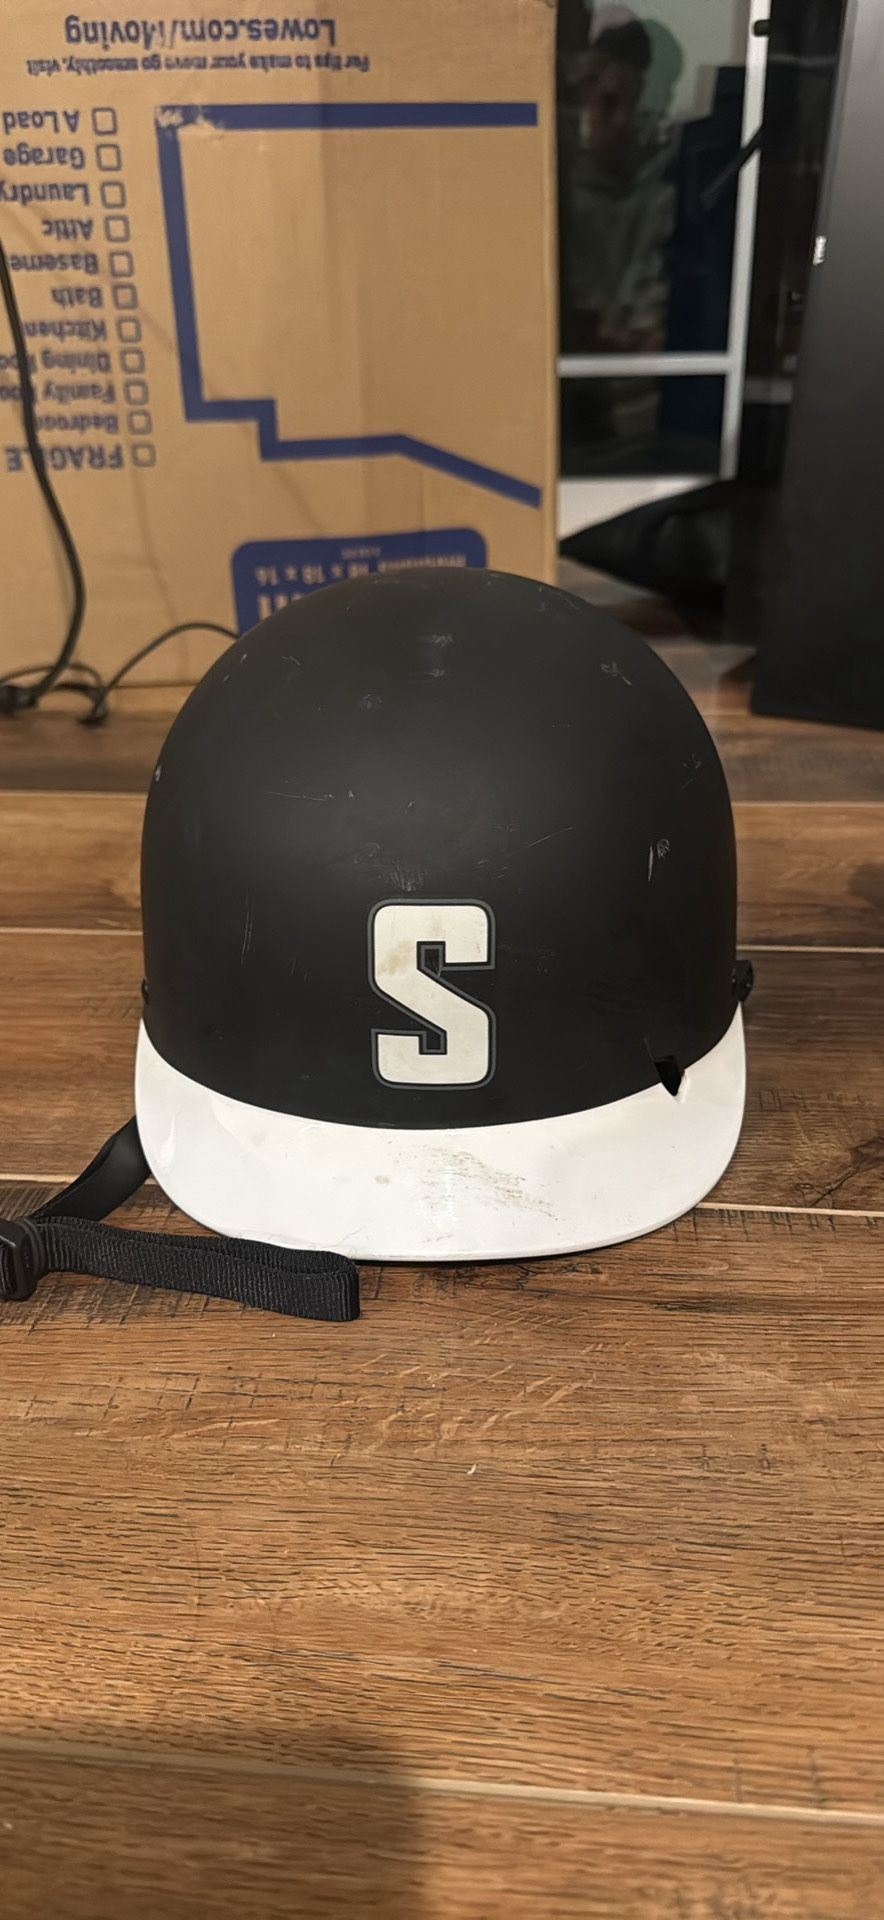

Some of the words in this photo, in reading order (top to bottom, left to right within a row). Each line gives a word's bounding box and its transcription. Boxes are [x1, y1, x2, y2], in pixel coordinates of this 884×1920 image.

[142, 53, 163, 71] go
[164, 56, 209, 70] move
[210, 53, 248, 70] your
[295, 56, 313, 70] to
[2, 110, 60, 134] Load
[63, 110, 80, 132] A
[3, 143, 85, 169] Garage
[42, 218, 94, 242] Attic
[52, 286, 103, 308] Bath
[25, 319, 108, 343] Kitchen
[41, 348, 111, 375] Dining
[43, 380, 115, 404] Family
[7, 444, 124, 472] FRAGE
[367, 898, 497, 1091] S
